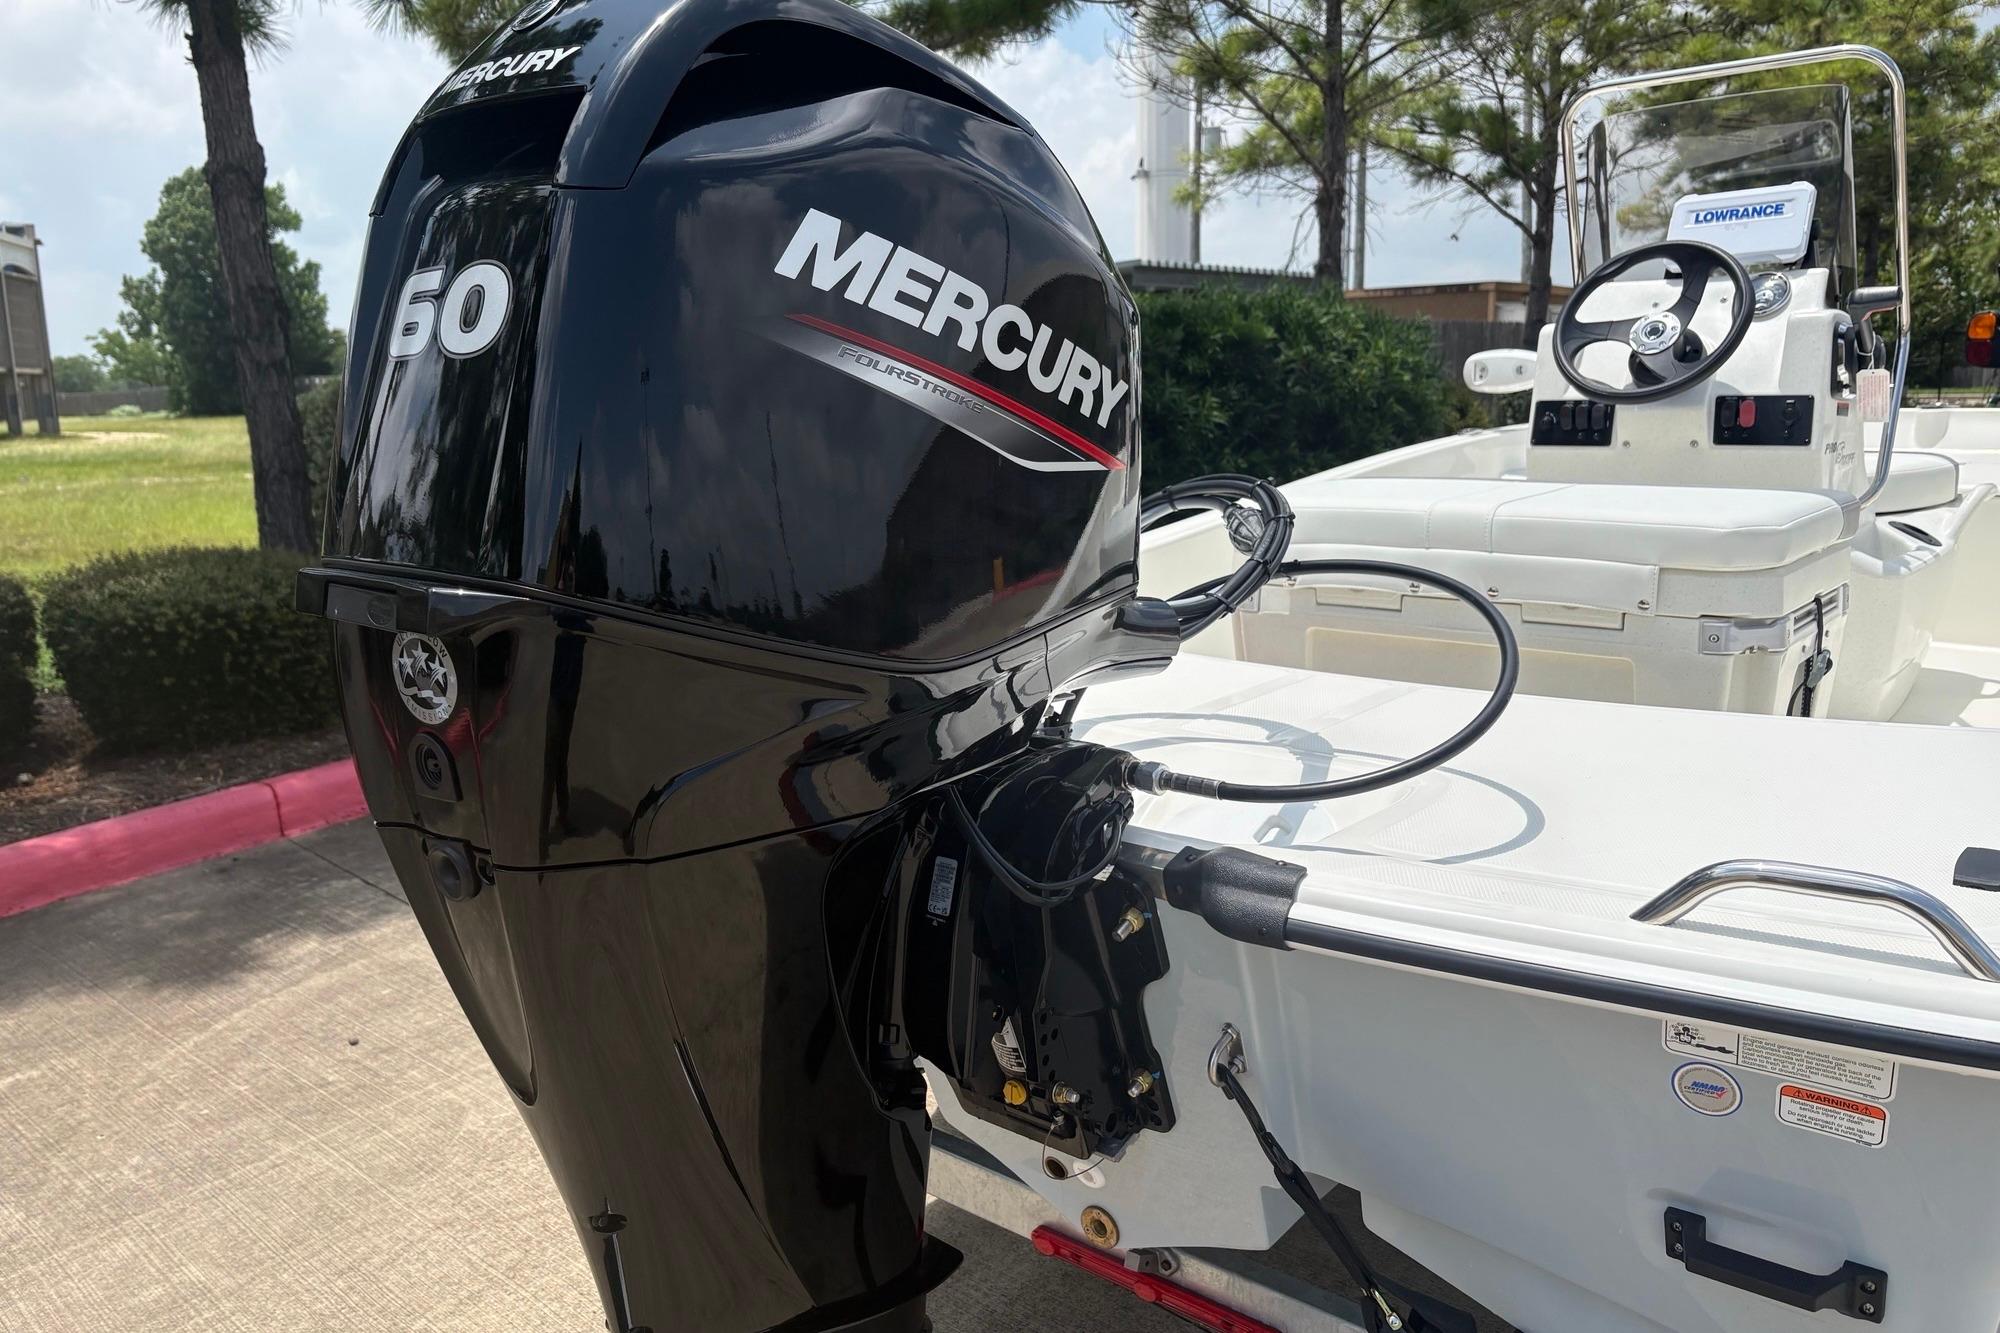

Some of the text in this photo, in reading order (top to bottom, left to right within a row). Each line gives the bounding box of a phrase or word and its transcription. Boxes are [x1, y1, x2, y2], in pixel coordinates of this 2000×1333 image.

[442, 46, 582, 95] MERCURY
[1694, 203, 1785, 224] LOWRANCE
[388, 259, 513, 361] 60
[774, 207, 1129, 429] MERCURY
[838, 344, 986, 414] FOURSTROKE
[1791, 1099, 1814, 1109] Rotating
[1816, 1106, 1841, 1116] propeller
[1857, 1116, 1875, 1124] cause
[1800, 1106, 1819, 1115] serious
[1821, 1111, 1836, 1119] injury
[1806, 1093, 1859, 1111] WARNING
[1797, 1117, 1812, 1125] when
[1814, 1122, 1833, 1130] engine
[1809, 1116, 1835, 1126] approach
[1857, 1128, 1875, 1137] ladder
